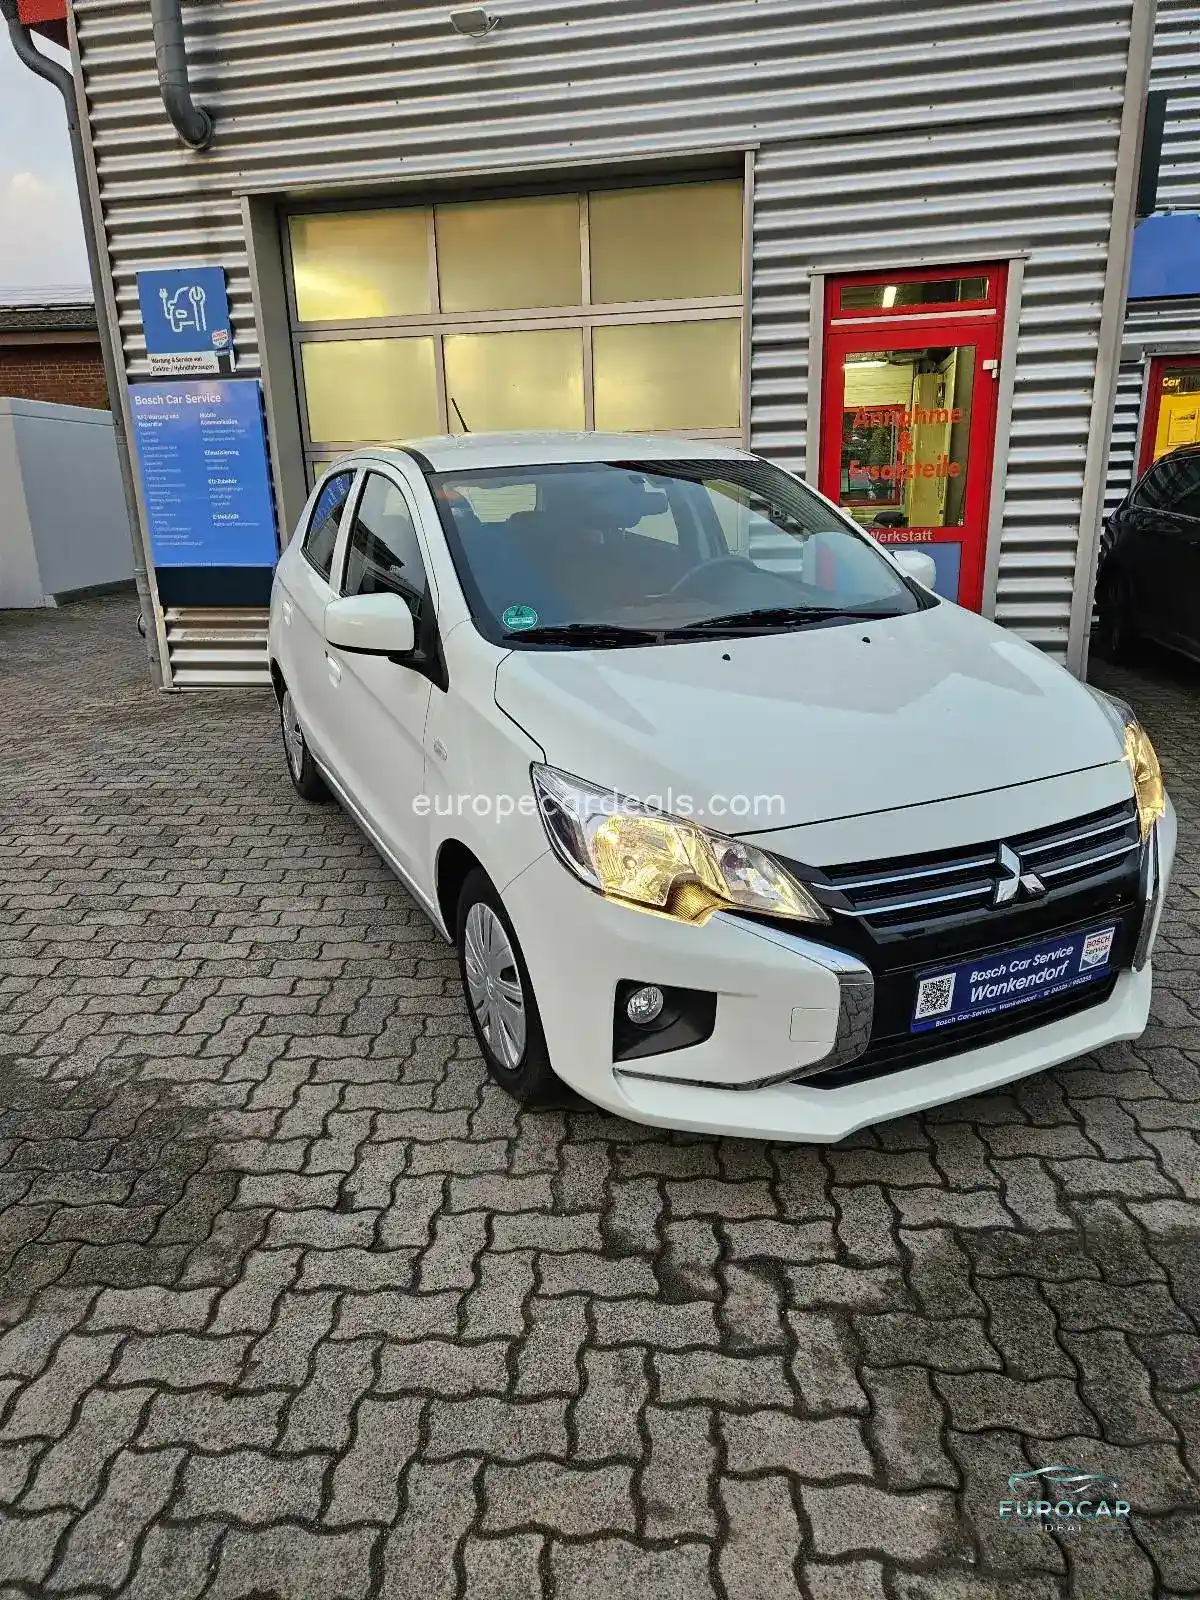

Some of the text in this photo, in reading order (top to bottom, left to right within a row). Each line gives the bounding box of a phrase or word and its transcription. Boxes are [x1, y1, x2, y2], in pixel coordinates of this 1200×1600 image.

[135, 392, 222, 406] Bosch Car Service
[852, 405, 962, 428] Annahme
[899, 431, 914, 453] &
[848, 455, 962, 480] Ersatzteile
[1086, 935, 1110, 948] BOSCH
[970, 945, 1074, 983] Bosch Car Service
[970, 960, 1070, 1003] Wankendorf
[935, 1016, 956, 1027] Bosch
